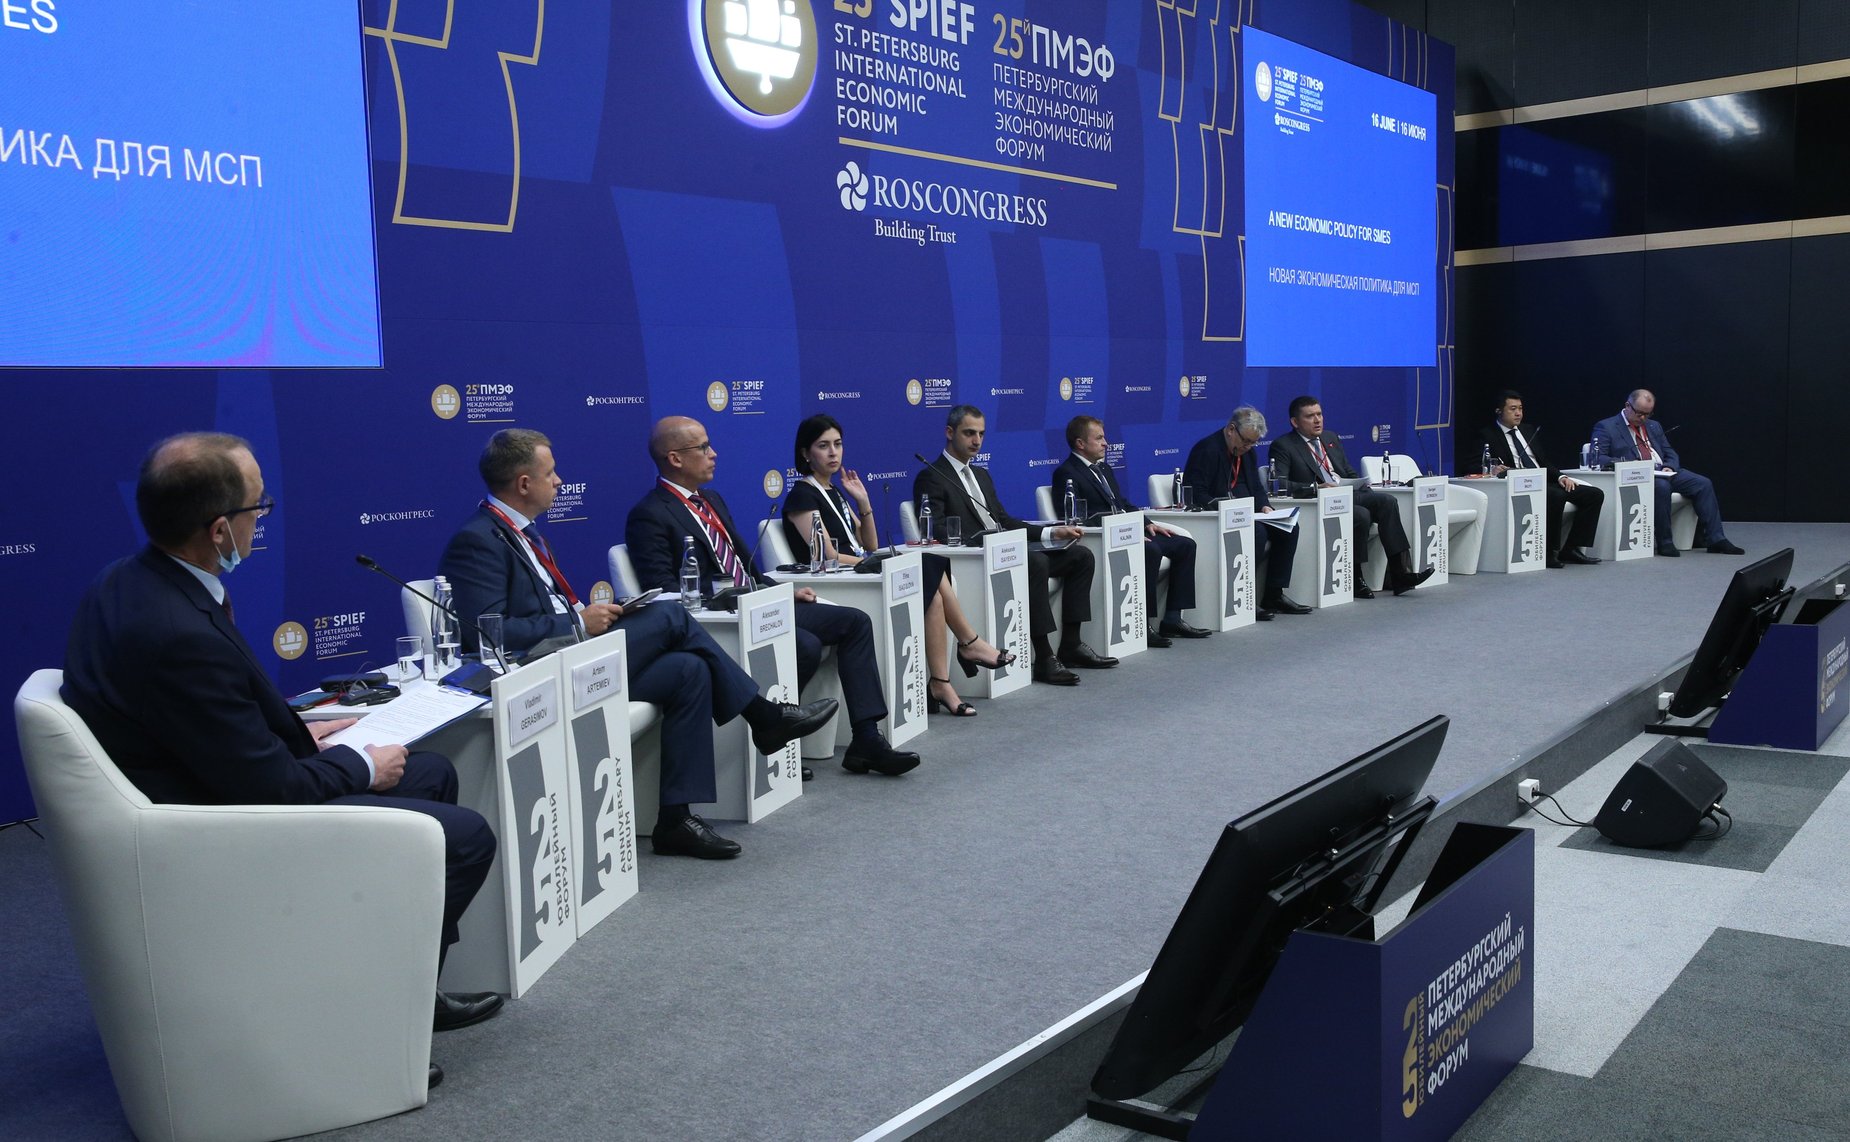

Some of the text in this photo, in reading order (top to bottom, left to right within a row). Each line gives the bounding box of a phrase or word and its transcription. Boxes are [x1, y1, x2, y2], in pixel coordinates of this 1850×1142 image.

[889, 0, 975, 45] SPIEF
[834, 22, 960, 72] ST. PETERSBURG
[1032, 24, 1115, 82] ПМЭФ
[836, 50, 966, 98] INTERNATIONAL
[994, 63, 1098, 105] ПЕТЕРБУРГСКИЙ
[836, 78, 927, 116] ECONOMIC
[994, 88, 1114, 130] МЕЖДУНАРОДНЫЙ
[838, 106, 898, 135] FORUM
[995, 112, 1112, 152] ЭКОНОМИЧЕСКИЙ
[1372, 112, 1379, 127] 16
[1380, 116, 1396, 133] JUNE
[1400, 122, 1408, 136] 16
[1408, 124, 1426, 141] ИЮНЯ
[0, 127, 263, 188] ИКА ДЛЯ МСП
[996, 136, 1044, 162] ФОРУМ
[873, 175, 1048, 227] ROSCONGRESS
[874, 218, 956, 246] Building Trust
[1268, 210, 1391, 244] A NEW ECONOMIC POLICY FOR SMES
[1270, 267, 1296, 284] НОВАЯ
[1297, 270, 1358, 290] ЭКОНОМИЧЕСКАЯ
[1359, 277, 1392, 294] ПОЛИТИКА
[1392, 281, 1406, 296] ДЛЯ
[480, 384, 514, 394] ПМЭФ
[595, 396, 645, 404] РОСКОНГРЕСС
[744, 380, 764, 390] SPIEF
[976, 453, 991, 462] SPIEF
[561, 483, 587, 494] SPIEF
[372, 510, 435, 522] РОСКОНГРЕСС
[0, 544, 36, 555] GRESS
[315, 632, 362, 643] INTERNATIONAL
[333, 612, 366, 626] SPIEF
[316, 640, 348, 650] ECONOMIC
[521, 706, 547, 730] GERASIMOV
[615, 756, 627, 873] ANNIVERSARY
[550, 793, 563, 926] ЮБИЛЕЙНЫЙ
[624, 811, 633, 871] FORUM
[561, 847, 569, 918] ФОРУМ
[1428, 912, 1512, 1008] ПЕТЕРБУРГСКИЙ
[1428, 926, 1525, 1036] МЕЖДУНАРОДНЫЙ
[1428, 958, 1521, 1068] ЭКОНОМИЧЕСКИЙ
[1427, 1038, 1468, 1095] ФОРУМ
